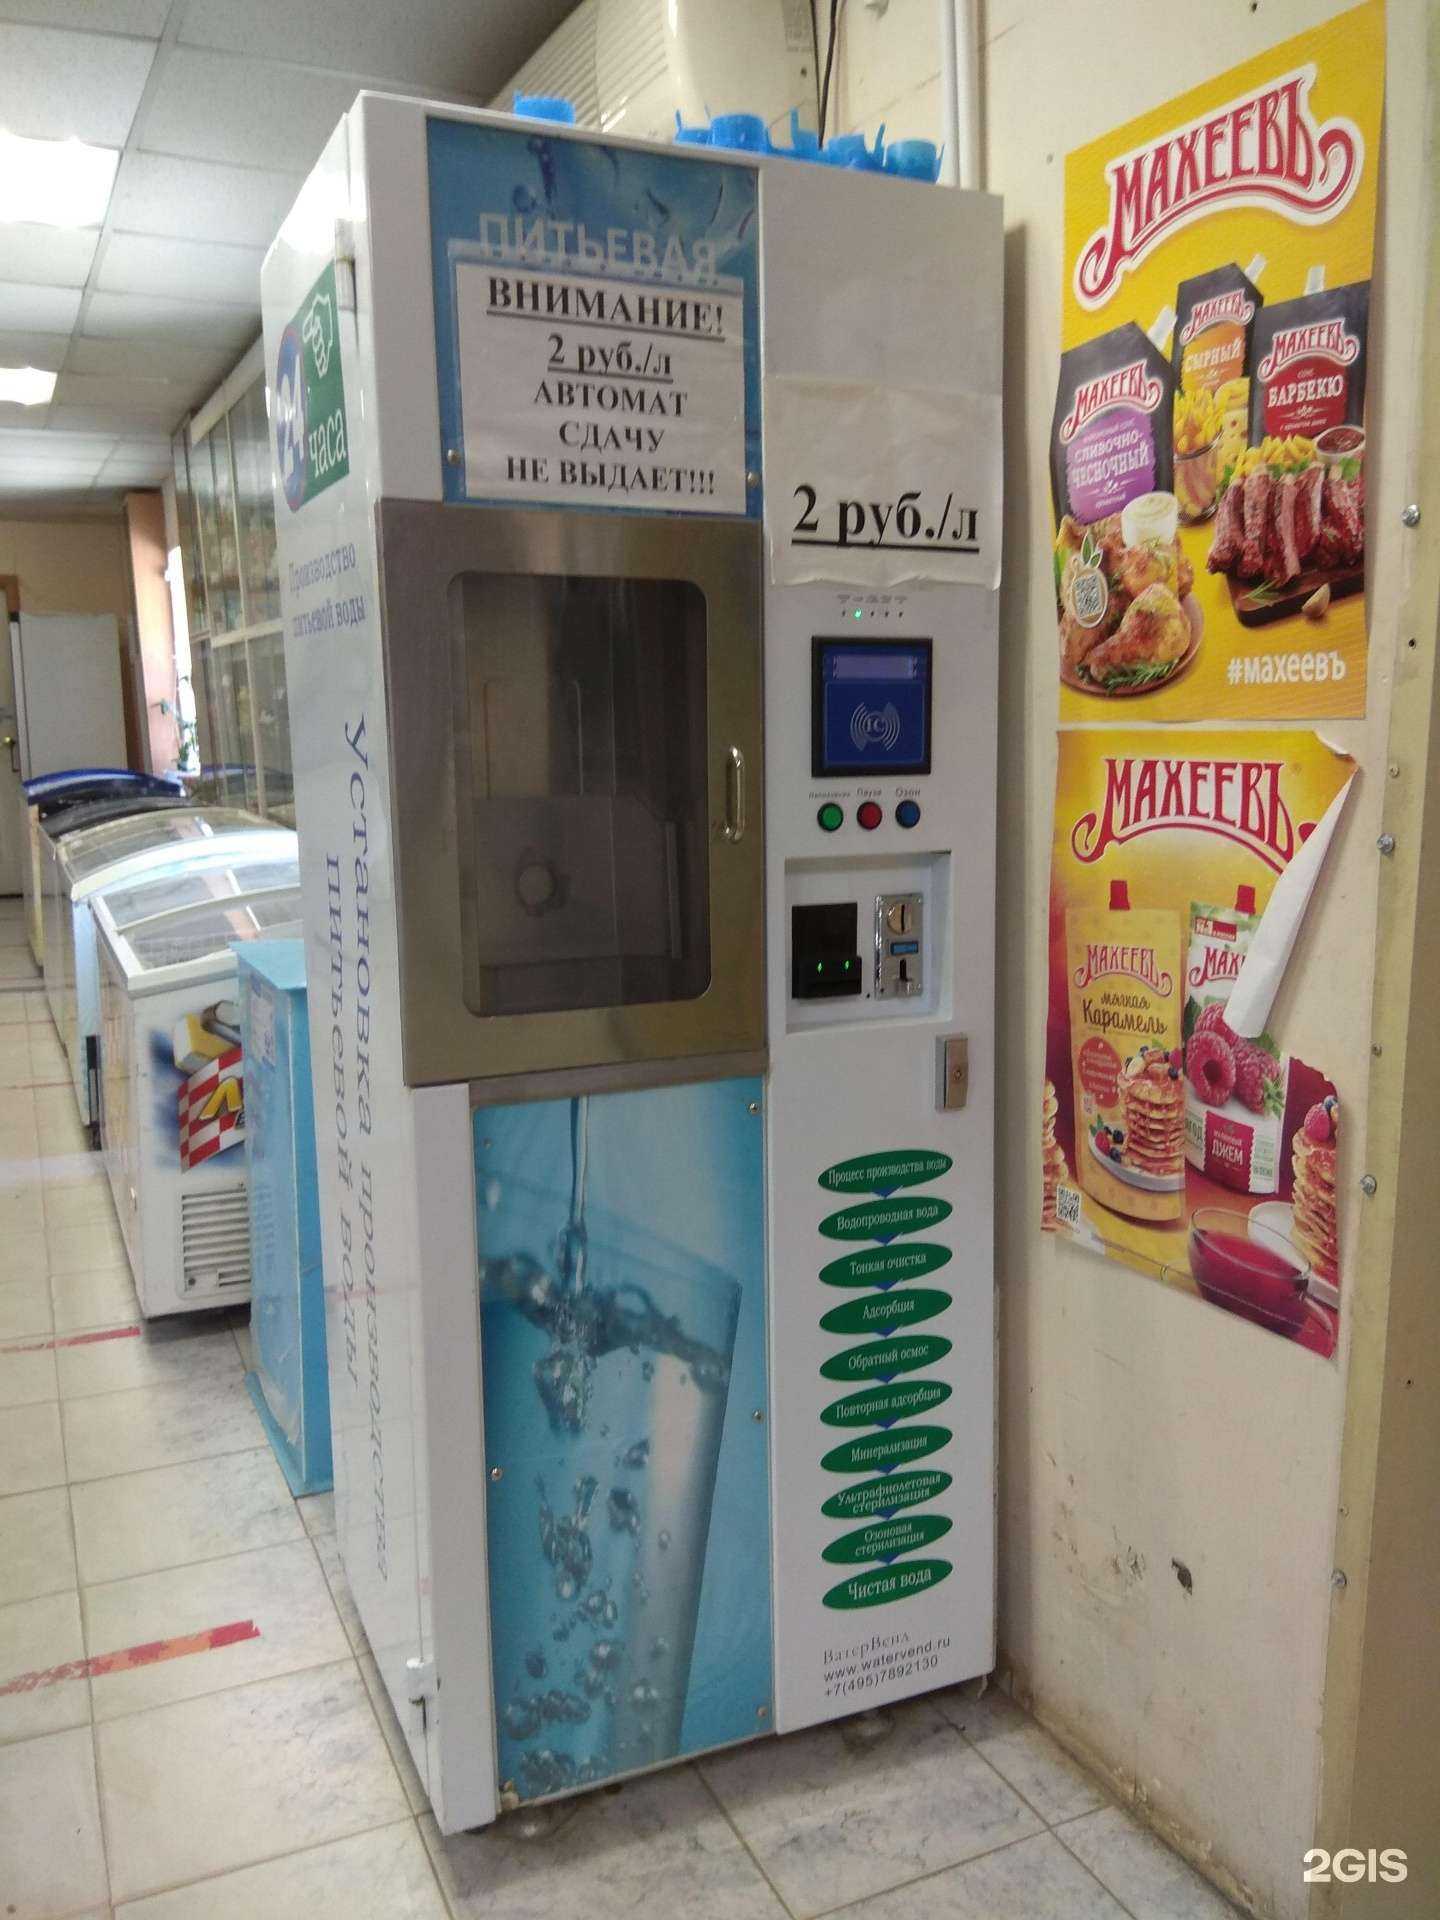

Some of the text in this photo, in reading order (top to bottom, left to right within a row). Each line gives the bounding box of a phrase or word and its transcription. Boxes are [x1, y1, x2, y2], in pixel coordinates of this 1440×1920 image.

[1078, 76, 1354, 299] МАХЕЕВЪ
[479, 212, 718, 280] ПИТЬЕВАЯ
[487, 276, 725, 338] ВНИМАНИЕ!
[547, 333, 673, 377] 2 руб./л
[533, 380, 688, 417] АВТОМАТ
[308, 407, 347, 478] часа
[558, 420, 665, 453] СДАЧУ
[506, 456, 715, 495] НЕ ВЫДАЕТ!!!
[793, 484, 979, 547] 2 руб./л
[335, 596, 366, 627] воды
[1072, 758, 1295, 864] МАХЕЕВЪ
[344, 712, 372, 1136] Установка
[1082, 999, 1167, 1034] Карамель
[326, 852, 359, 1390] питьевой воды
[1212, 1139, 1243, 1165] ДЖЕМ
[828, 1168, 865, 1187] Процесс
[837, 1205, 939, 1230] Водопроводная вода
[850, 1253, 927, 1275] Тонкая очистка
[862, 1300, 915, 1320] Адсорбция
[848, 1344, 929, 1371] Обратный осмос
[835, 1387, 941, 1420] Повторная адсорбция
[851, 1436, 928, 1462] Минерализация
[853, 1487, 930, 1514] стерилизация
[855, 1532, 924, 1556] стерилизация
[864, 1523, 912, 1542] Озоновая
[848, 1568, 932, 1600] Чистая вода
[824, 1637, 950, 1682] www.watervend.ru
